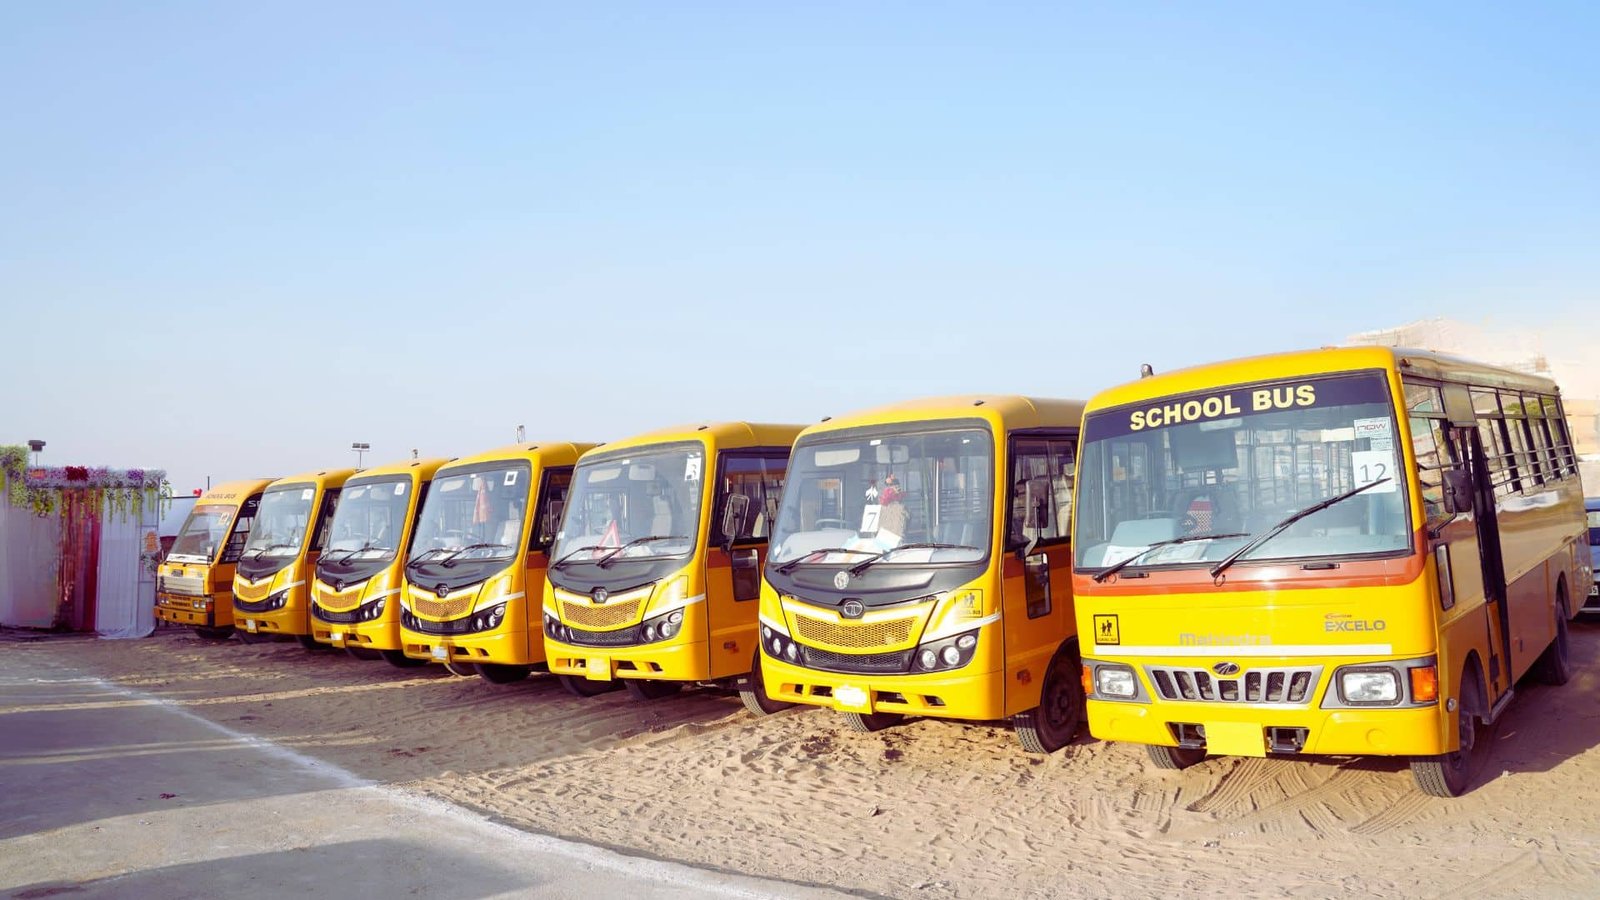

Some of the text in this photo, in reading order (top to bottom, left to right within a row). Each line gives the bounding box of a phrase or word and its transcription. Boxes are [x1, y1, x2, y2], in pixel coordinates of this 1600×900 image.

[1130, 385, 1316, 431] SCHOOL BUS
[1360, 463, 1386, 483] 12
[867, 512, 877, 531] 7
[1325, 620, 1386, 632] EXCELO
